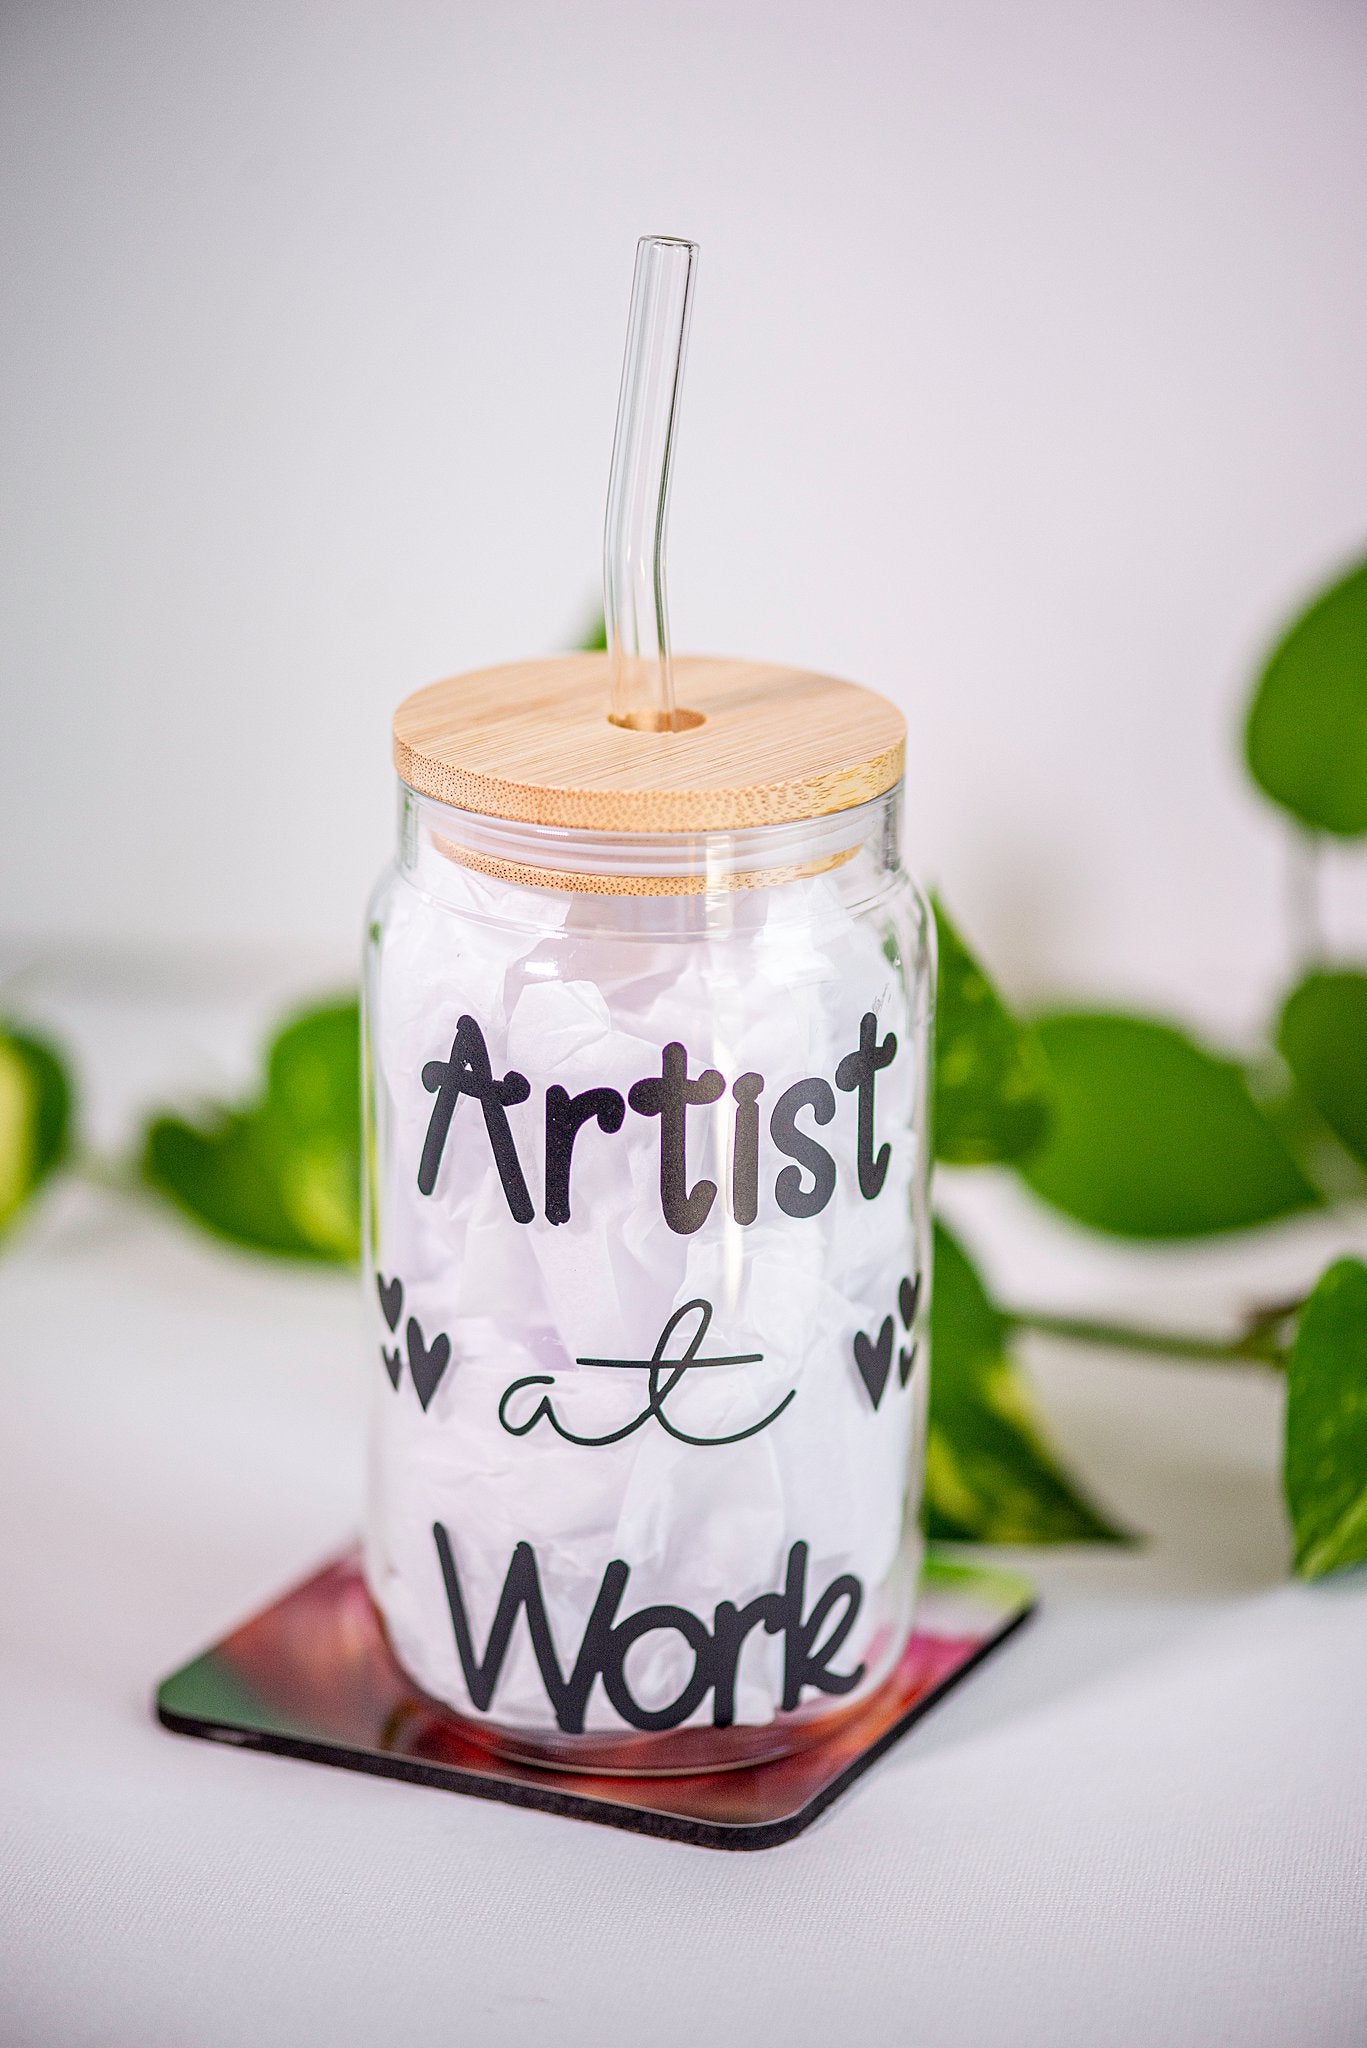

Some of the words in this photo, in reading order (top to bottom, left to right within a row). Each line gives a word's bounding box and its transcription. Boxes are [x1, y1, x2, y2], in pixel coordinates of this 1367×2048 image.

[417, 1011, 898, 1235] Artist
[498, 1298, 797, 1447] at
[432, 1521, 866, 1734] Work
